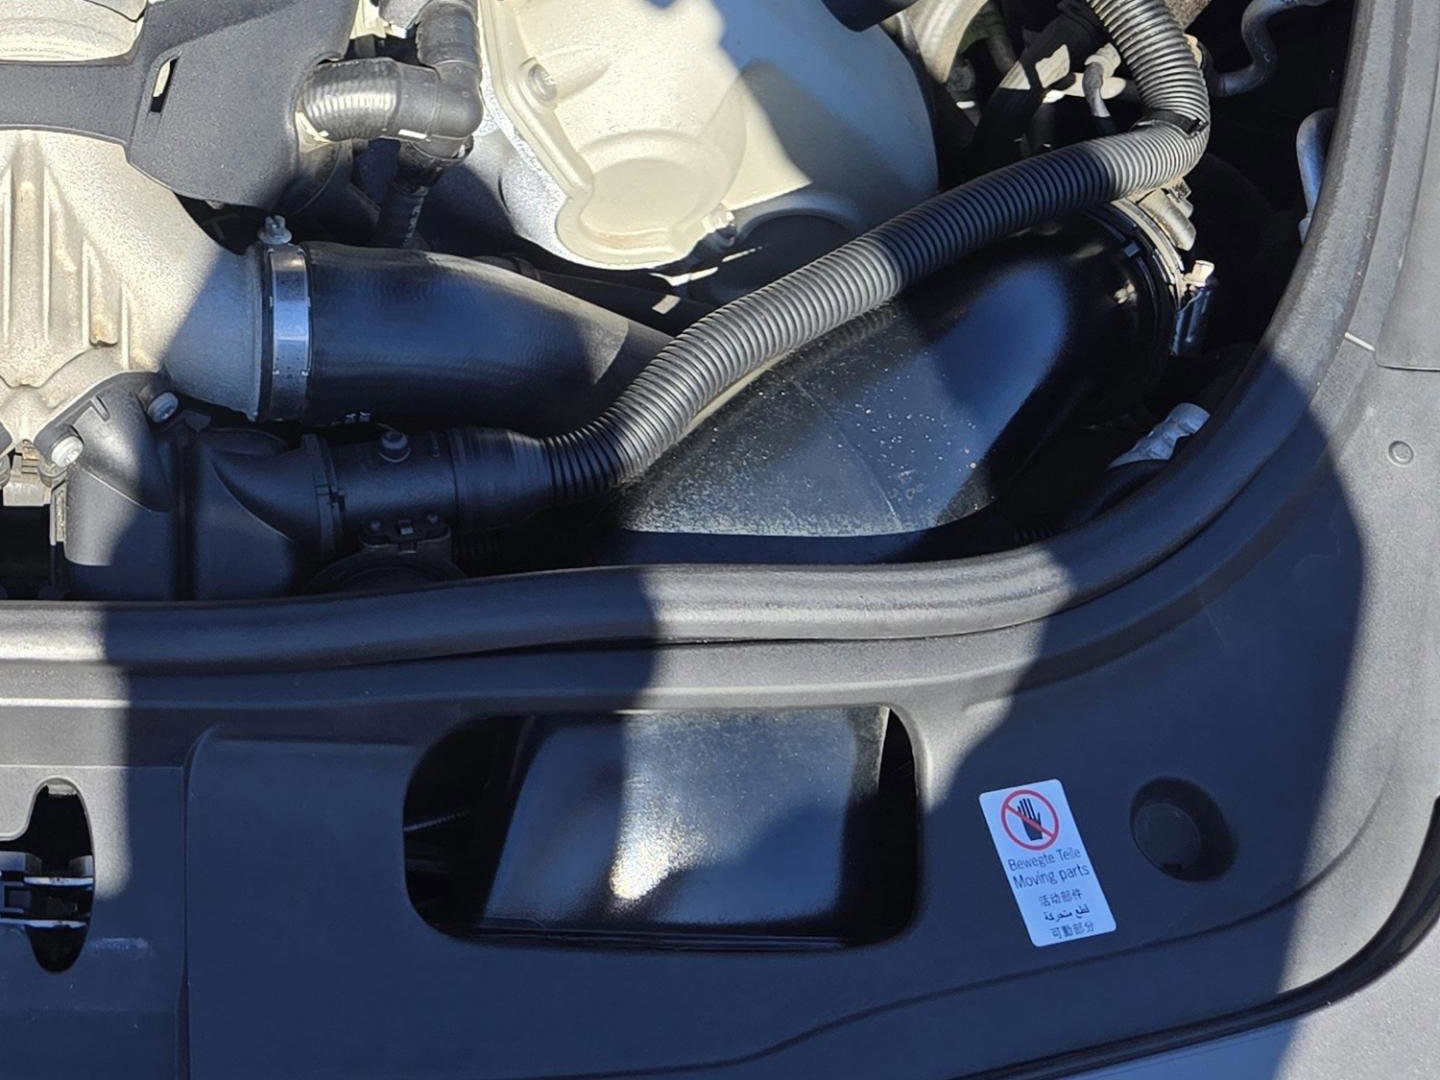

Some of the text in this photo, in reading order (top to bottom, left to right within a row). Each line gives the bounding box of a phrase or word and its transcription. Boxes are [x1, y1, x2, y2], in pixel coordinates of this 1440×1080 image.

[1008, 847, 1081, 871] Bewegte Teile
[1013, 864, 1090, 889] Moving parts
